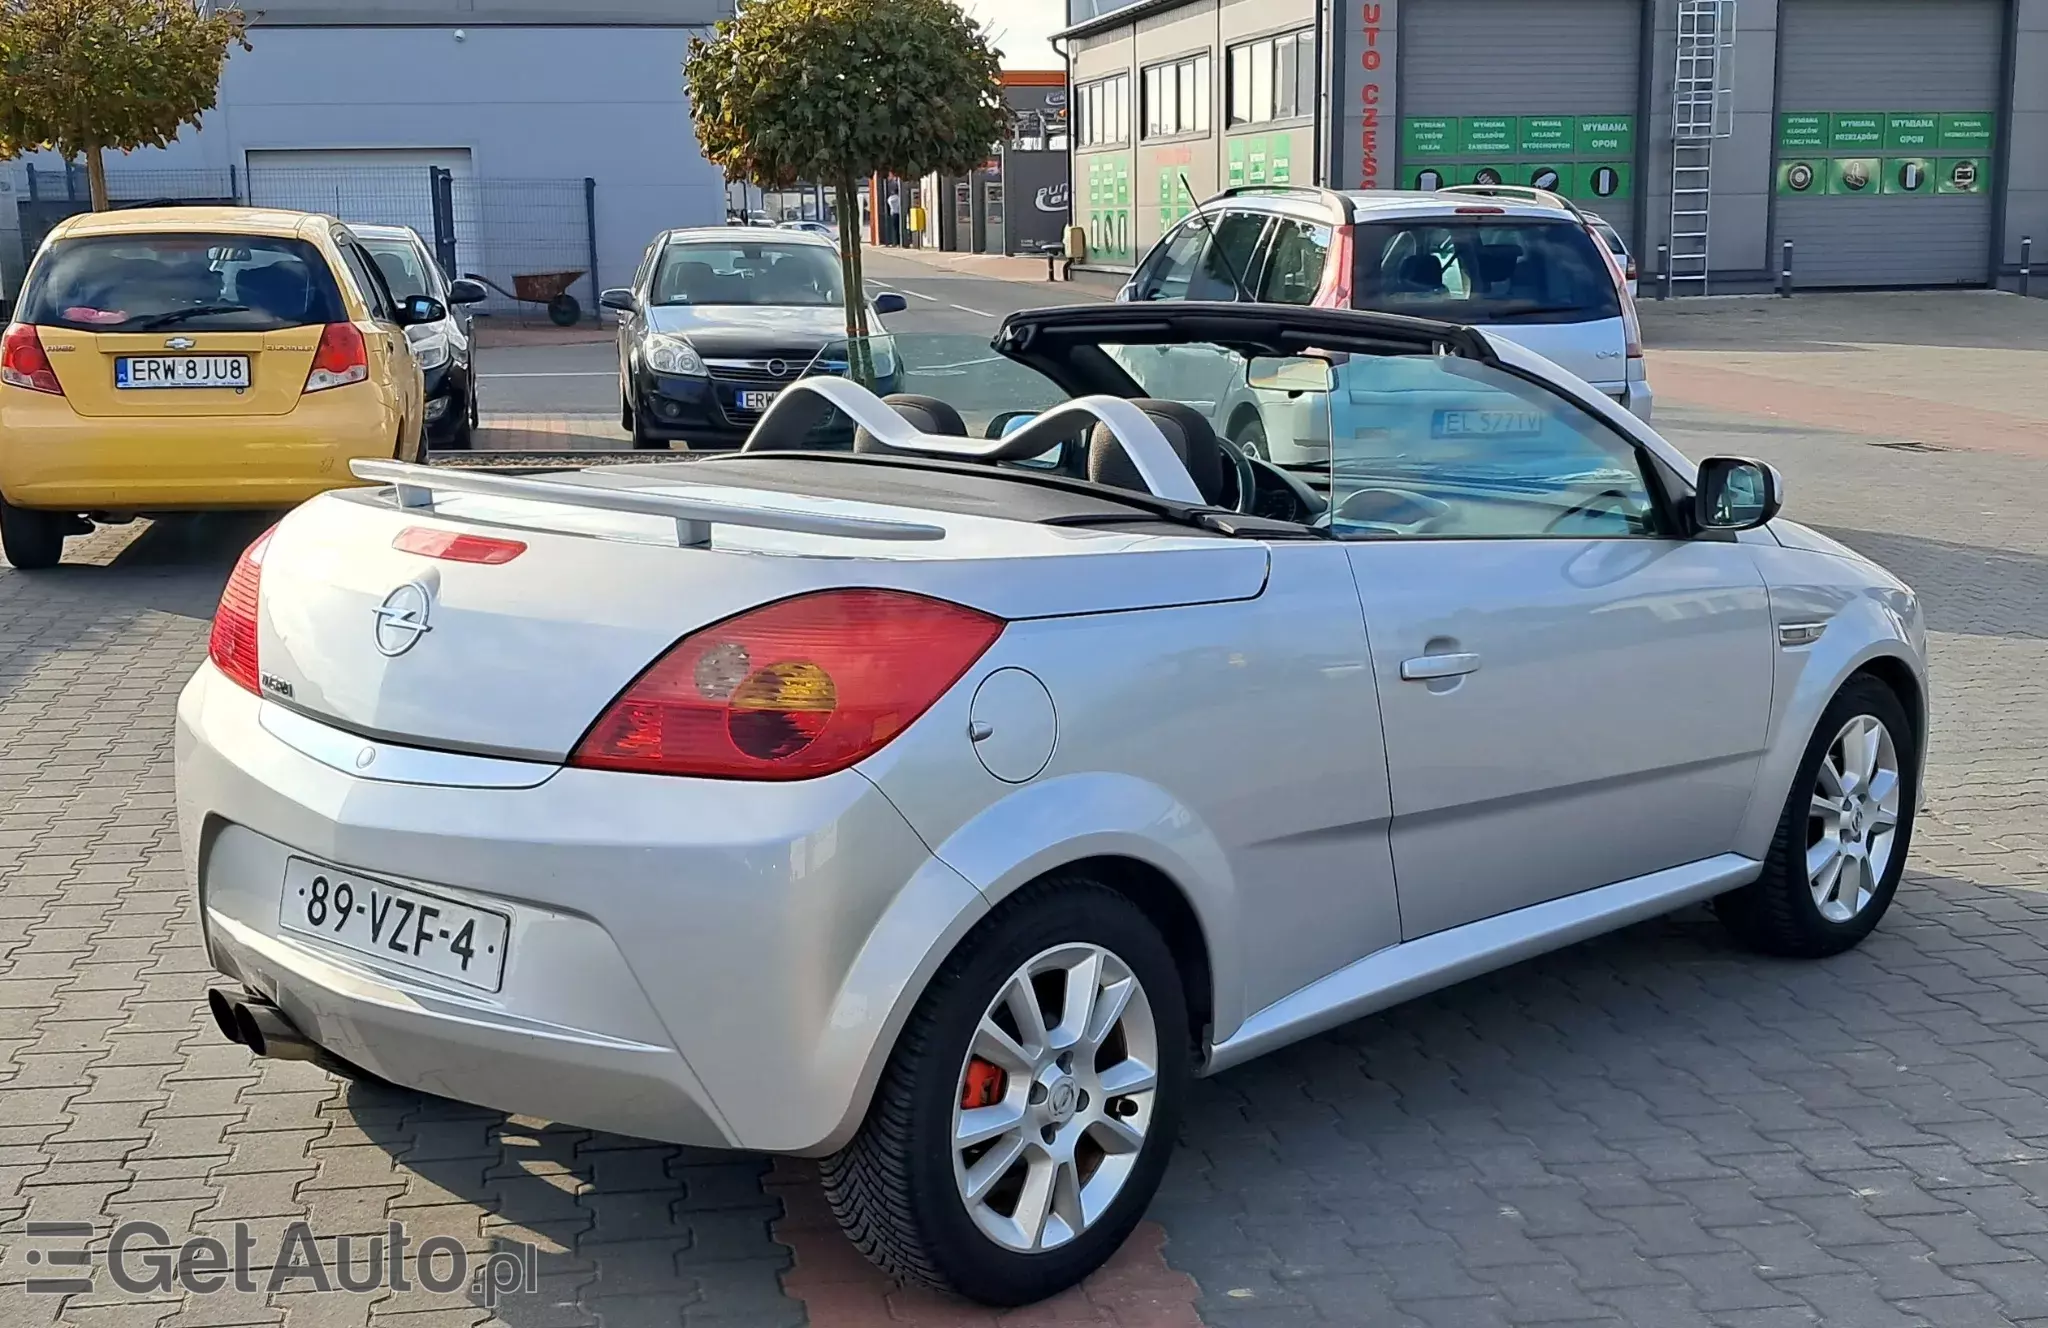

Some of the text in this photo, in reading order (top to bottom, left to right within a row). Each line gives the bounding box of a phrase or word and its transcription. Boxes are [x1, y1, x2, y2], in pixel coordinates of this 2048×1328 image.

[1361, 2, 1381, 70] UTO
[1582, 122, 1628, 132] WYMIANA
[1891, 119, 1935, 128] WYMIANA
[1591, 139, 1618, 148] OPON
[1899, 135, 1925, 143] OPON
[132, 359, 176, 380] ERW
[185, 359, 242, 380] 8JU8
[1447, 413, 1471, 432] EL
[306, 875, 476, 971] 89-VZF-4
